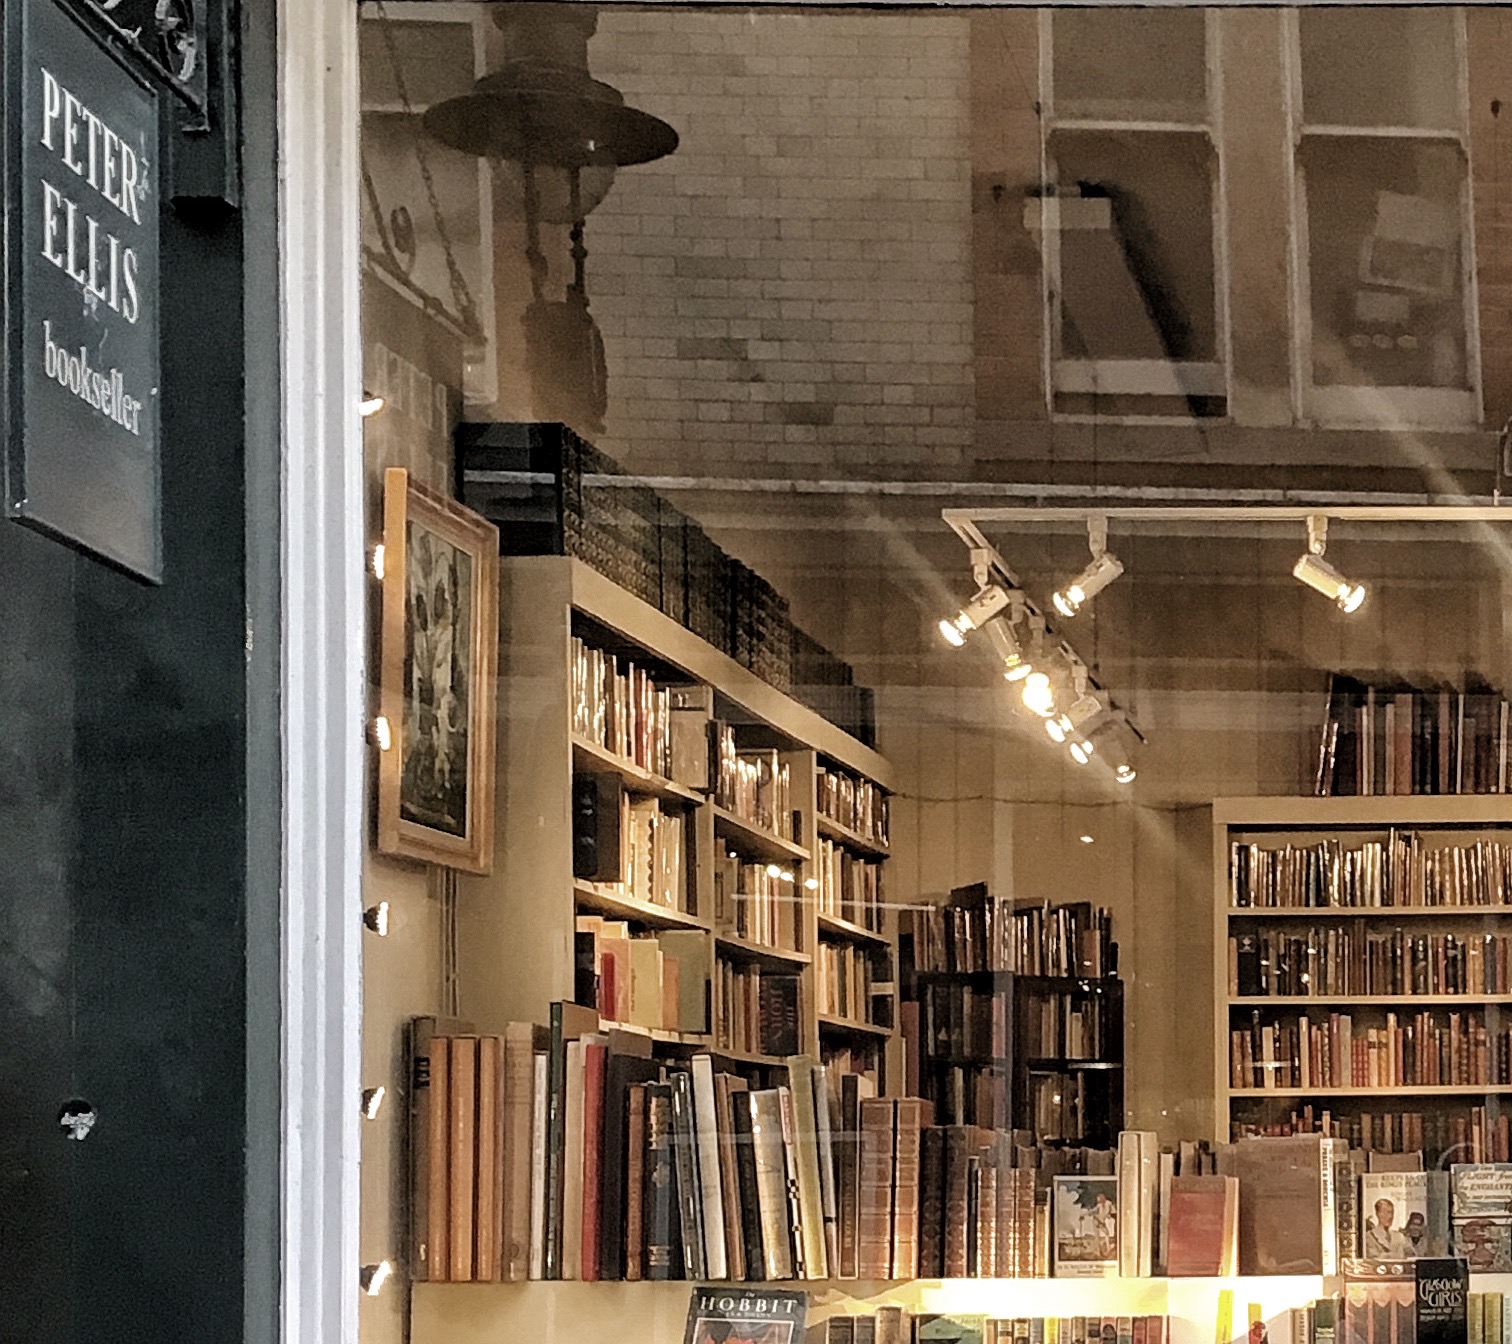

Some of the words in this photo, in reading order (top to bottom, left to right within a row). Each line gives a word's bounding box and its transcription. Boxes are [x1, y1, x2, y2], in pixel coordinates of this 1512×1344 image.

[41, 67, 142, 226] PETER
[41, 178, 140, 325] ELLIS
[43, 319, 142, 436] bookseller
[700, 1295, 798, 1314] HOBBIT
[1427, 1290, 1463, 1307] GIRLS
